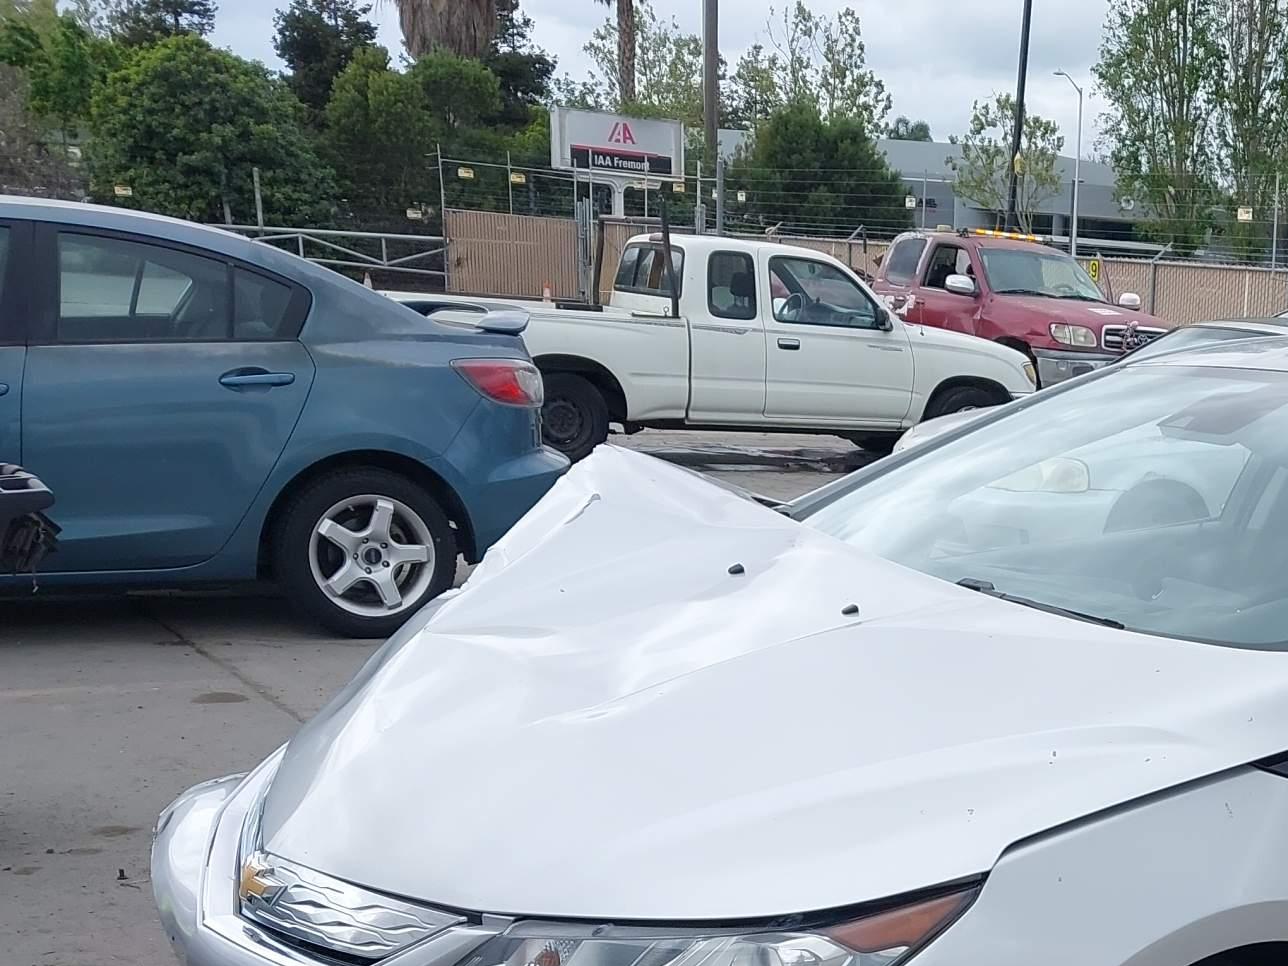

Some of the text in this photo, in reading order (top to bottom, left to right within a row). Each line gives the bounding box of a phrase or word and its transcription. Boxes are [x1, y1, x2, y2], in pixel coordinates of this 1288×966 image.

[594, 155, 650, 171] IAA Fremont
[1091, 262, 1097, 278] 9
